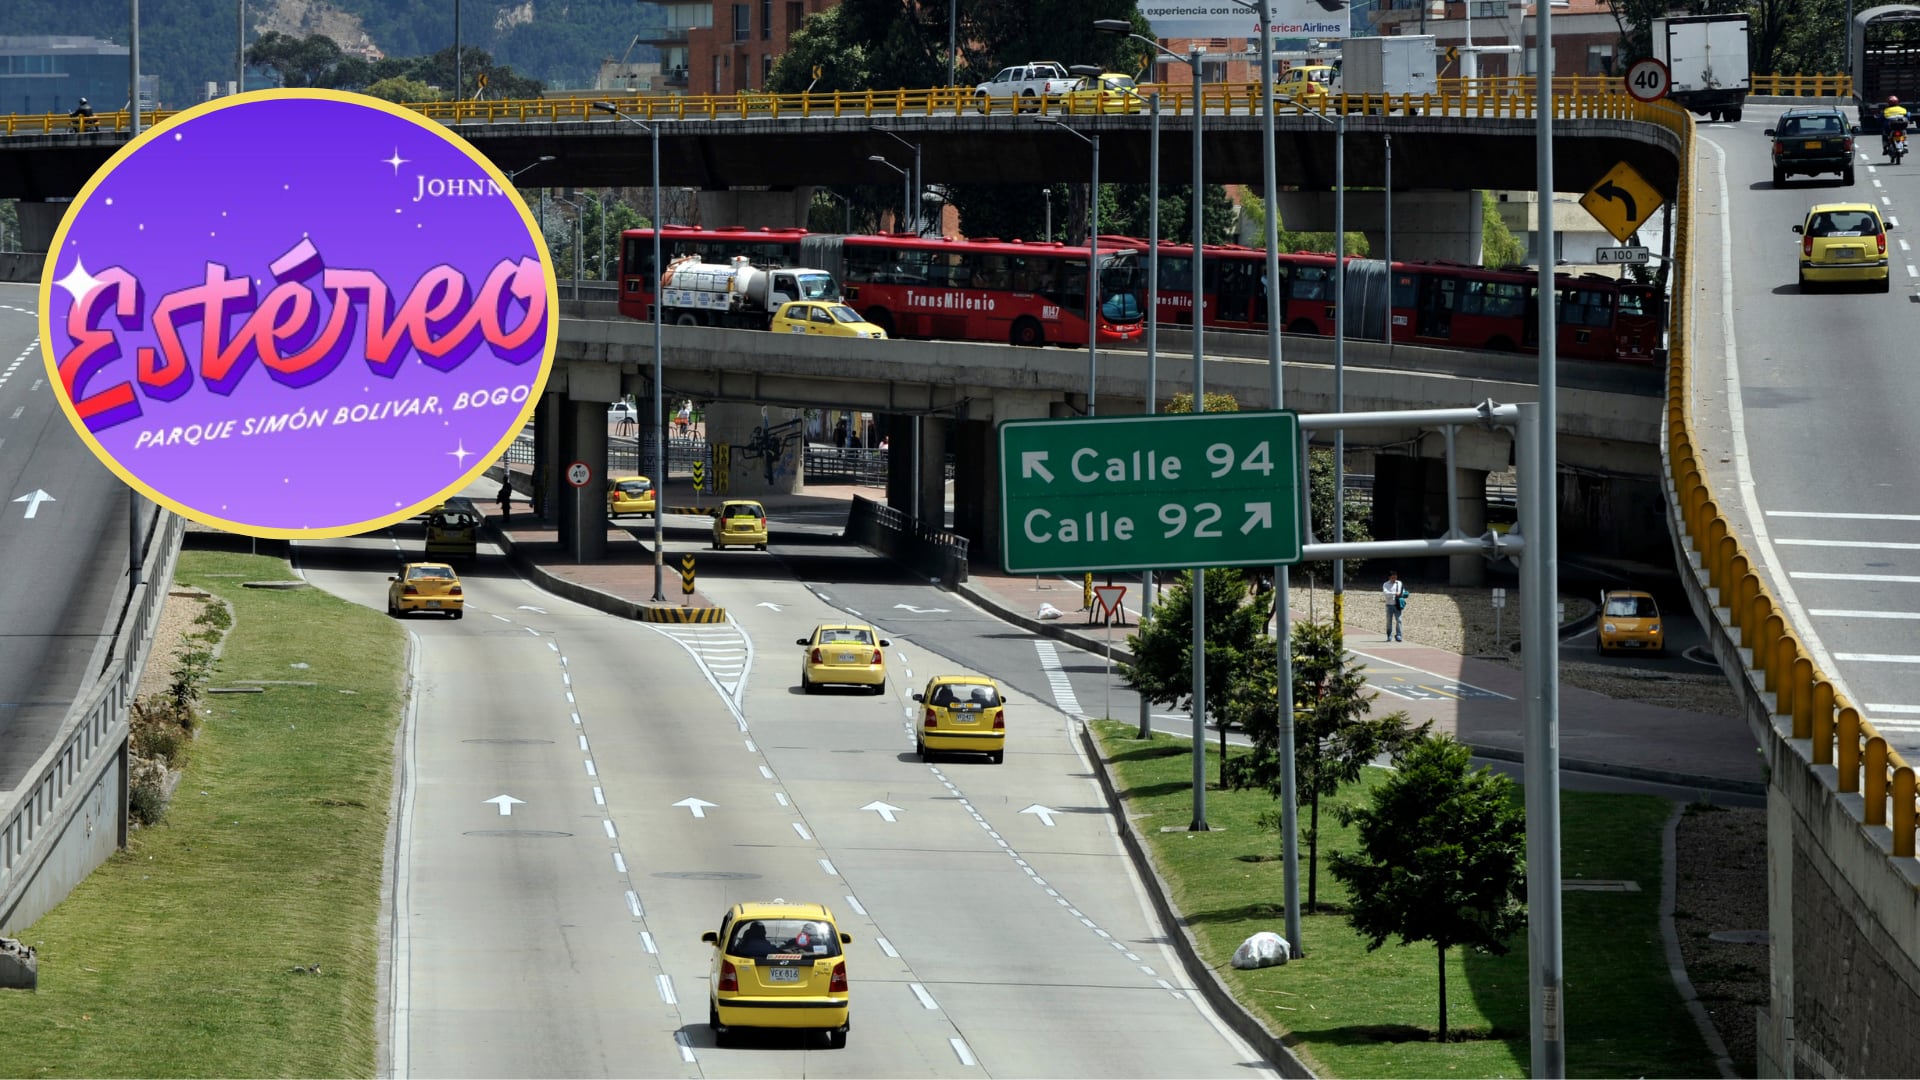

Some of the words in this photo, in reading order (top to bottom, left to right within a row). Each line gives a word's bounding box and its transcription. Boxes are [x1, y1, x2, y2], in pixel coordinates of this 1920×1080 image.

[1147, 6, 1207, 17] experiencia
[1210, 7, 1229, 15] con
[1232, 6, 1277, 15] nosos
[1253, 22, 1341, 33] AericanAirlines
[1634, 70, 1659, 90] 40
[1600, 250, 1608, 261] A
[1614, 250, 1632, 260] 100
[1638, 252, 1646, 260] m
[906, 290, 995, 311] TransMilenio
[1071, 447, 1182, 483] Calle
[1205, 441, 1274, 479] 94
[1023, 508, 1135, 544] Calle
[1157, 502, 1223, 539] 92
